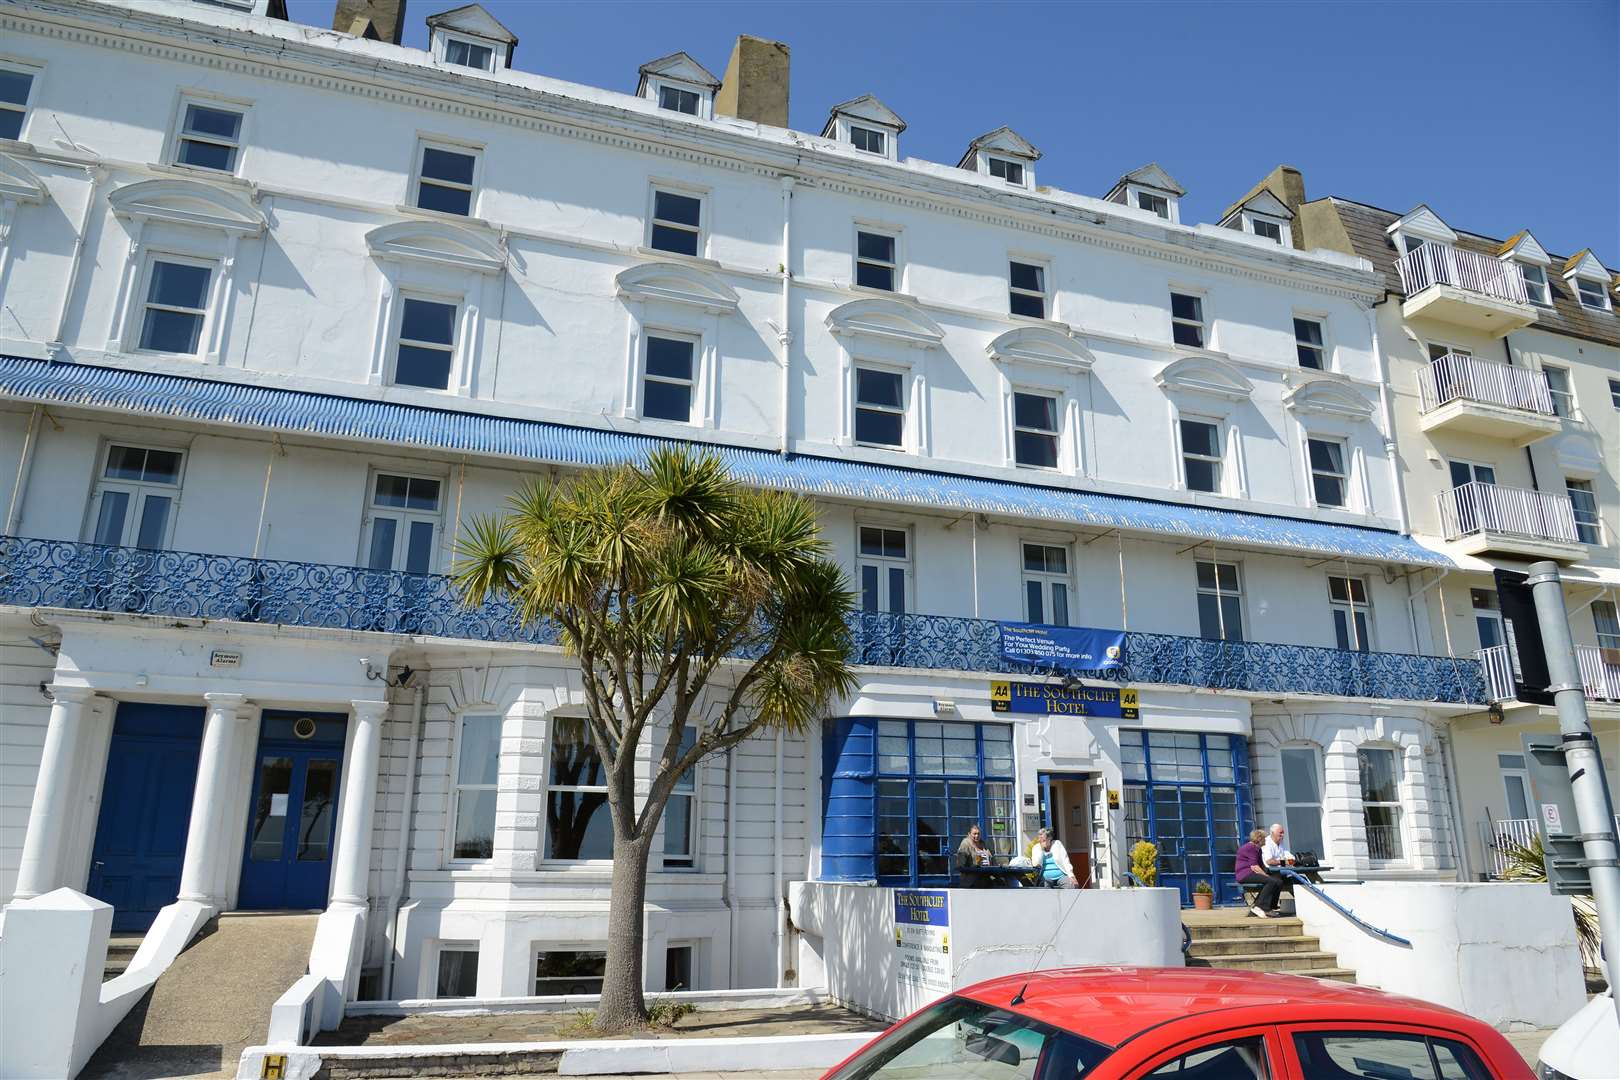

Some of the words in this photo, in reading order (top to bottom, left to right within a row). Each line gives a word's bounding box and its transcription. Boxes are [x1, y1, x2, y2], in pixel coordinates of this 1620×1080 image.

[994, 686, 1008, 696] AA
[1014, 683, 1040, 698] THE
[1124, 694, 1136, 704] AA
[1046, 700, 1088, 714] HOTEL
[264, 1056, 286, 1078] H
